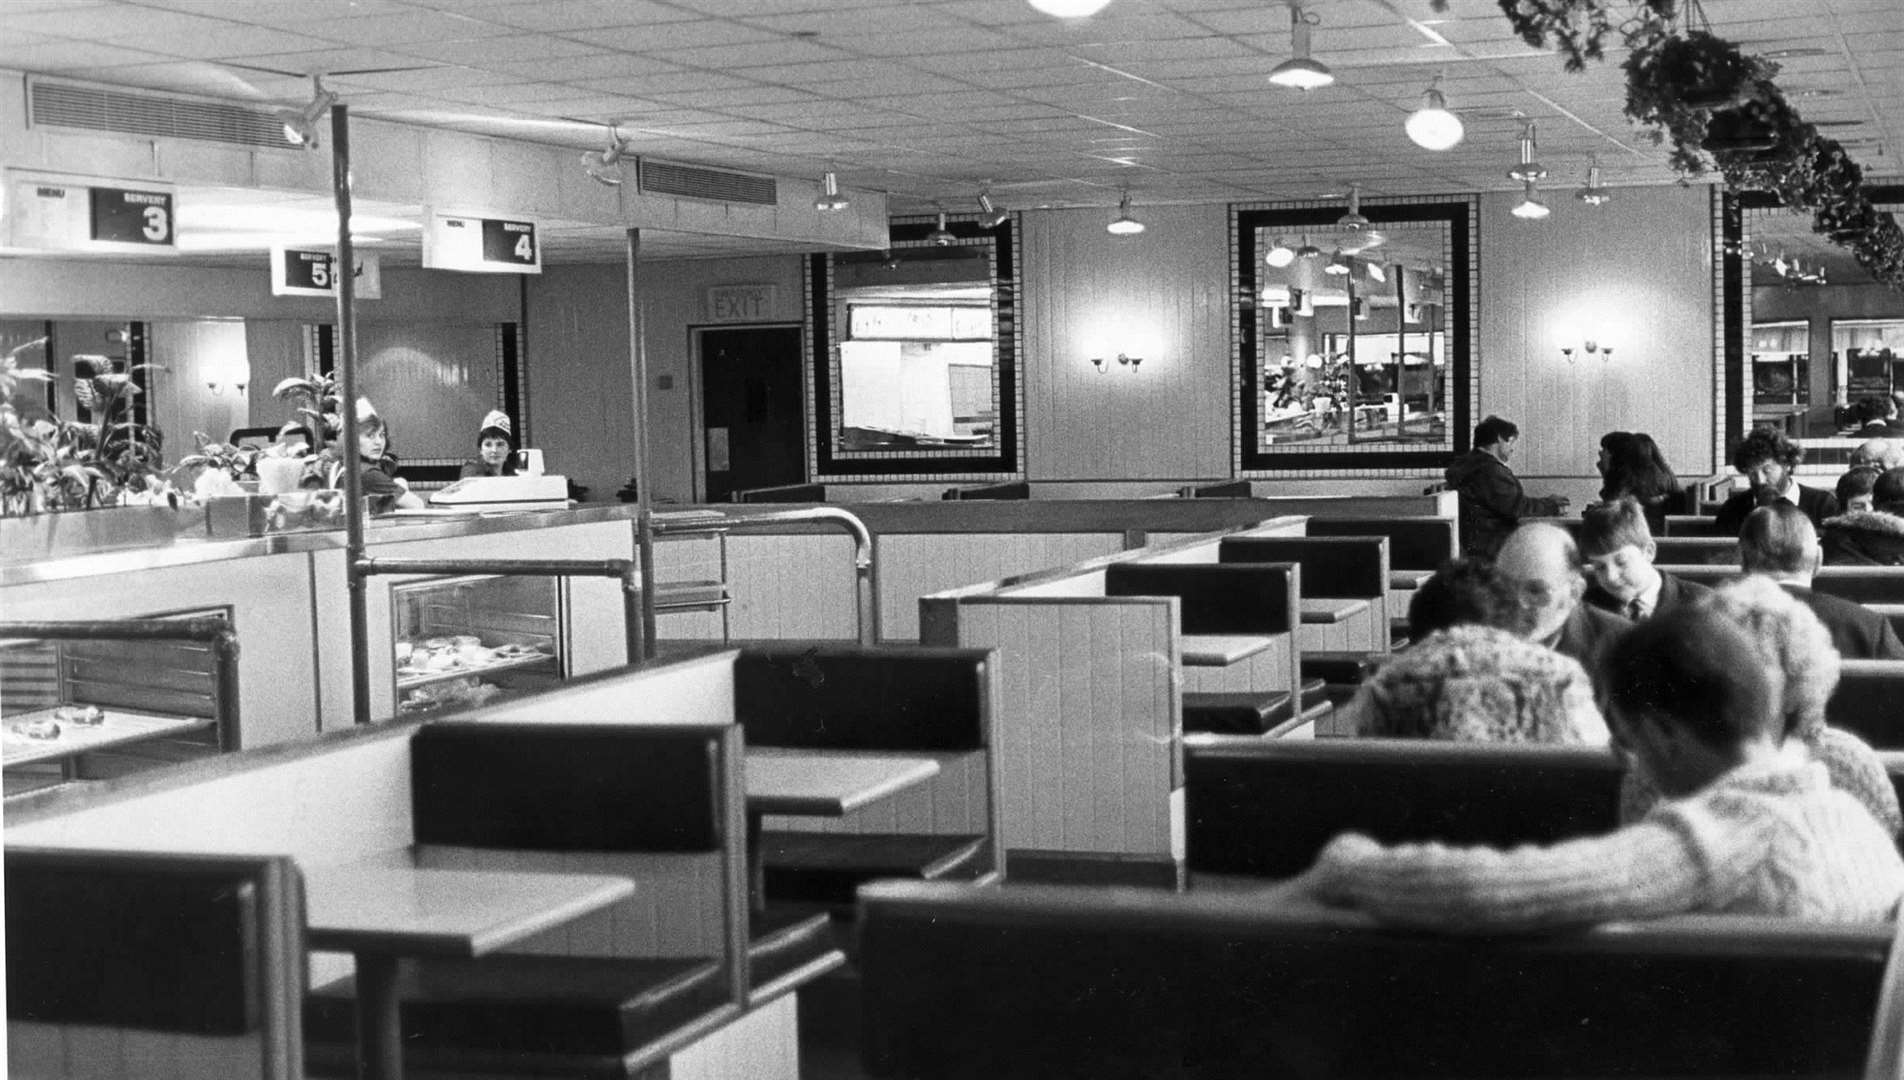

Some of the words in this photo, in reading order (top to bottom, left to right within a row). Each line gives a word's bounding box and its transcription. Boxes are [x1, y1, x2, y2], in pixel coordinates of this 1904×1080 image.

[143, 206, 167, 240] 3
[515, 234, 532, 260] 4
[311, 262, 328, 287] 5
[715, 296, 763, 317] EXIT
